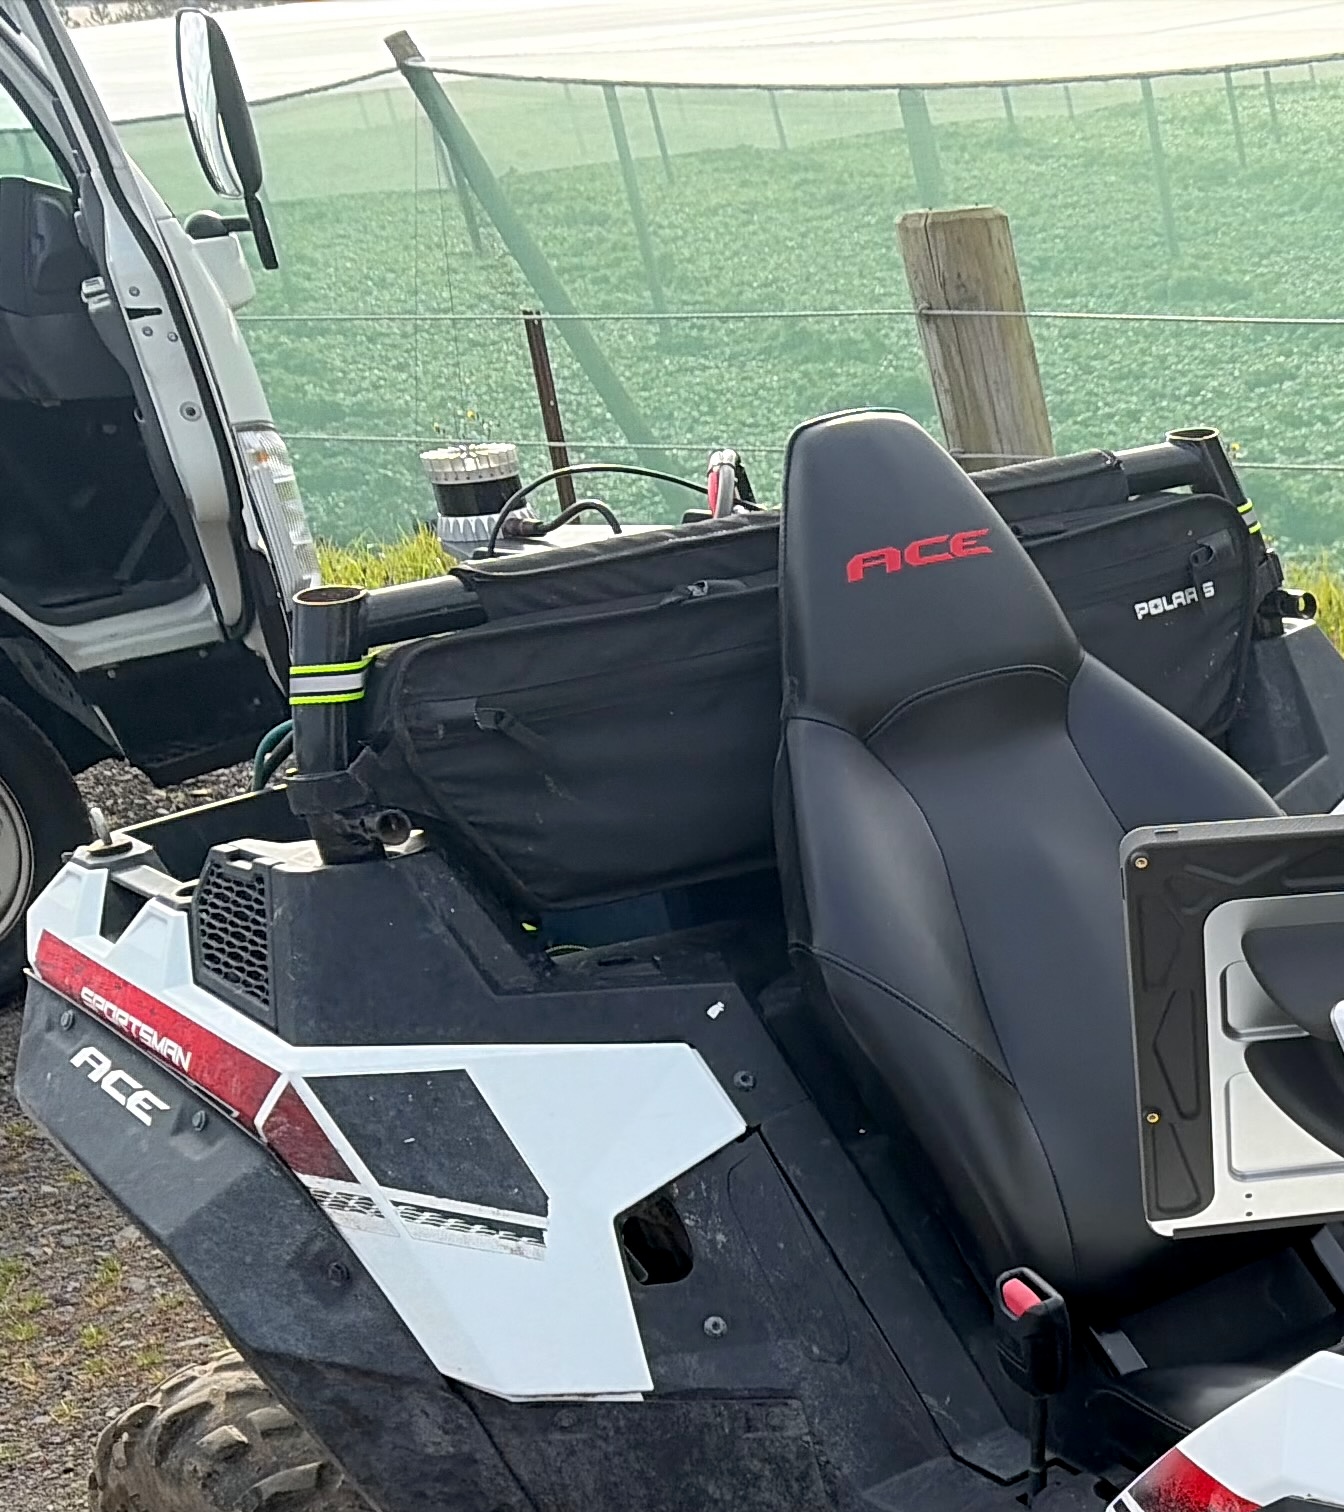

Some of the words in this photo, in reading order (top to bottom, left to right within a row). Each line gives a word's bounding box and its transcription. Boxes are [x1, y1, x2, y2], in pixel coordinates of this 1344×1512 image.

[846, 528, 992, 583] ACE
[1134, 581, 1215, 620] POLARS
[81, 986, 192, 1073] SPORTSMAN
[69, 1046, 171, 1127] ACE
